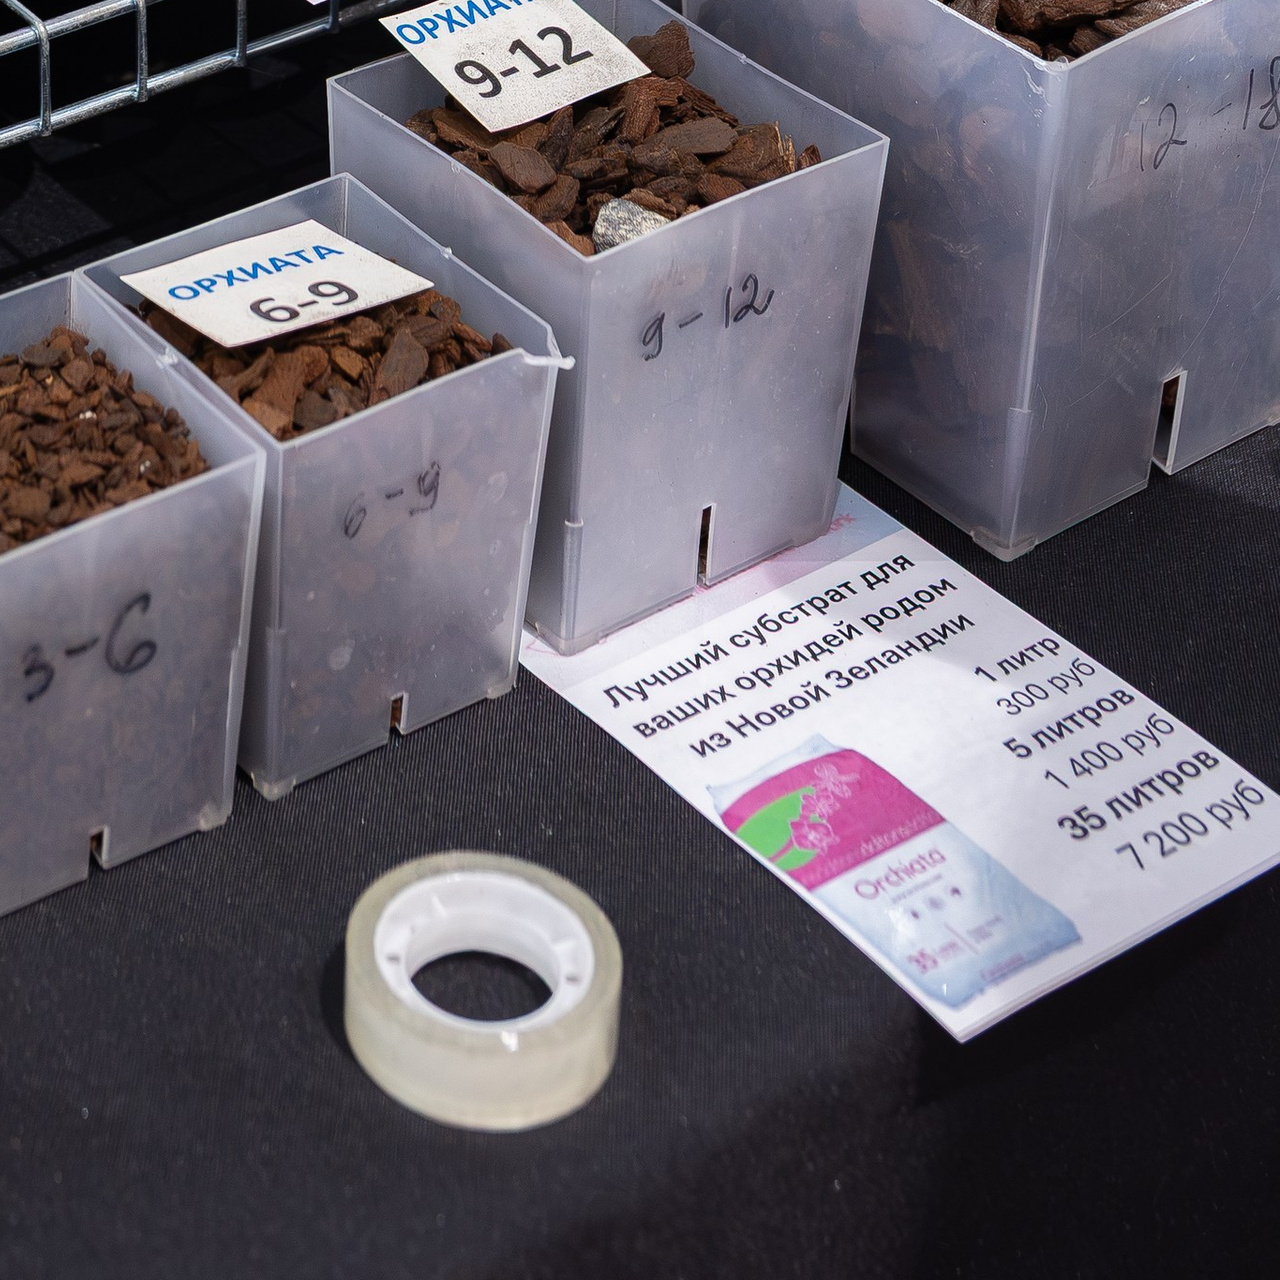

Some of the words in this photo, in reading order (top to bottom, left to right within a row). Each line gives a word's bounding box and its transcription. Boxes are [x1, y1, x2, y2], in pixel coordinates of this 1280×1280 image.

[454, 26, 593, 98] 9-12
[168, 242, 344, 301] ОРХИАТА
[249, 280, 359, 323] 6-9
[603, 640, 729, 708] Лучший
[730, 581, 858, 648] субстрат
[859, 554, 916, 590] для
[633, 684, 737, 738] ваших
[735, 621, 864, 692] орхидей
[860, 577, 958, 633] родом
[974, 665, 998, 683] 1
[998, 636, 1060, 677] литр
[689, 728, 732, 758] из
[727, 682, 833, 740] Новой
[825, 613, 976, 689] Зеландии
[997, 684, 1050, 716] 300
[1048, 658, 1096, 697] руб
[1003, 738, 1033, 760] 5
[1031, 689, 1135, 750] литров
[1057, 806, 1107, 841] 35
[1106, 751, 1221, 820] литров
[1115, 843, 1146, 871] 7
[1143, 810, 1210, 859] 200
[1206, 779, 1266, 830] руб
[853, 847, 947, 900] Orchiata
